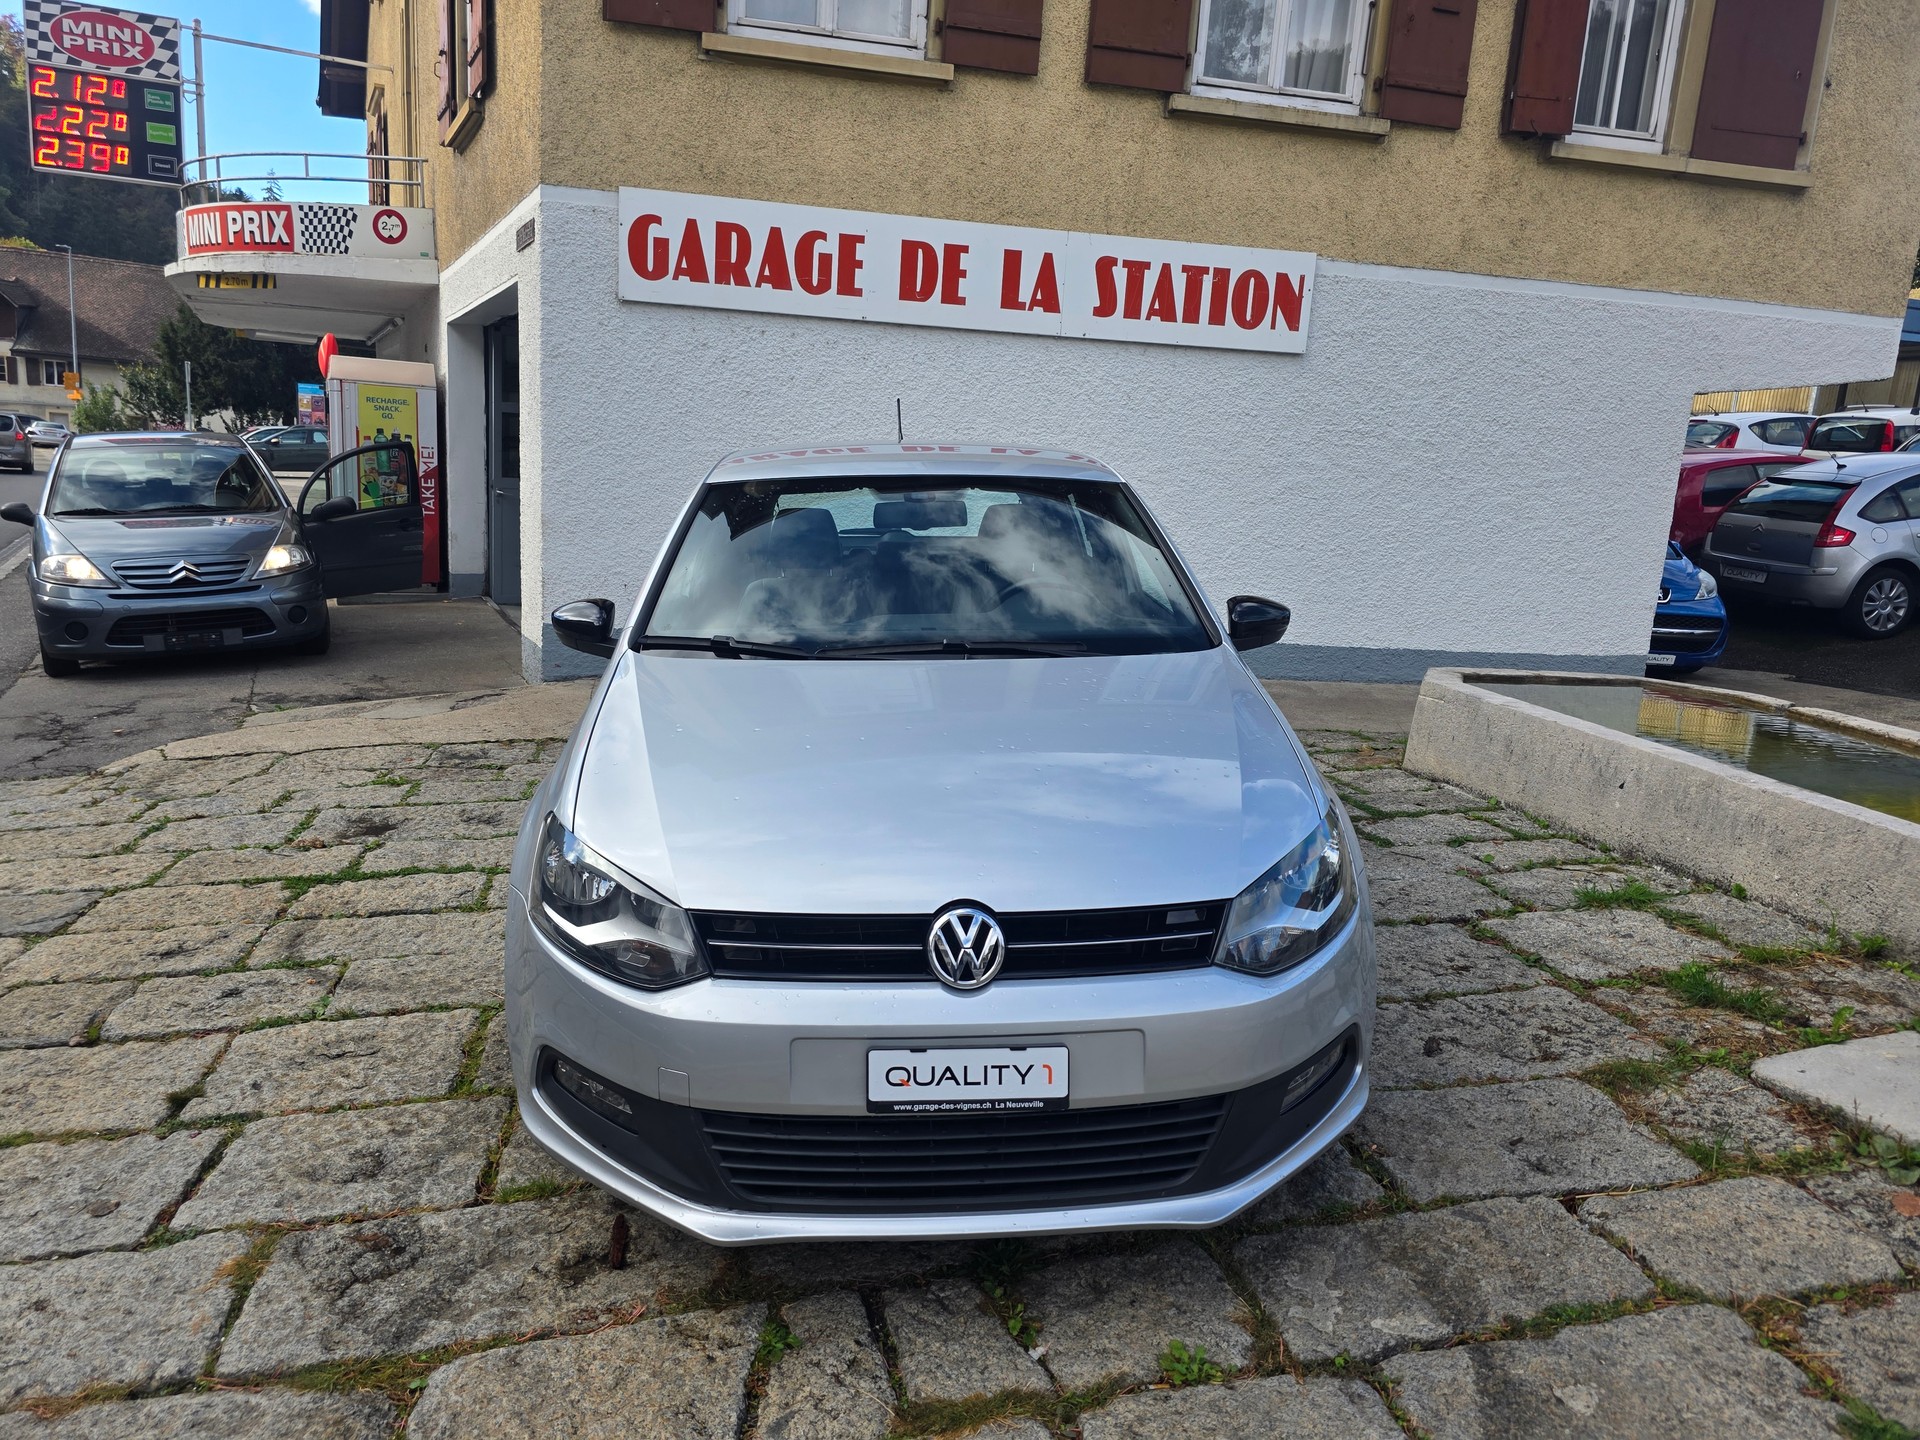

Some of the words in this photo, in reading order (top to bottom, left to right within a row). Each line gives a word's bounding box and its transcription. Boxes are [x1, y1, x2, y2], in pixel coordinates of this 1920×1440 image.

[62, 18, 144, 45] MINI
[62, 34, 145, 60] PRIX
[188, 211, 222, 247] MINI
[226, 210, 291, 246] PRIX
[627, 213, 865, 297] GARAGE
[898, 239, 970, 306] DE
[1000, 248, 1061, 314] LA
[1092, 255, 1307, 332] STATION
[366, 396, 410, 406] RECHARGE.
[373, 404, 402, 413] SNACK.
[381, 412, 395, 420] GO.
[420, 446, 435, 474] ME!
[421, 478, 435, 515] TAKE
[1727, 568, 1760, 579] QUALITY
[885, 1064, 1035, 1087] QUALITY
[894, 1102, 992, 1112] www.garage-des-vignes.ch
[995, 1101, 1005, 1109] La
[1006, 1100, 1044, 1109] Neuveville
